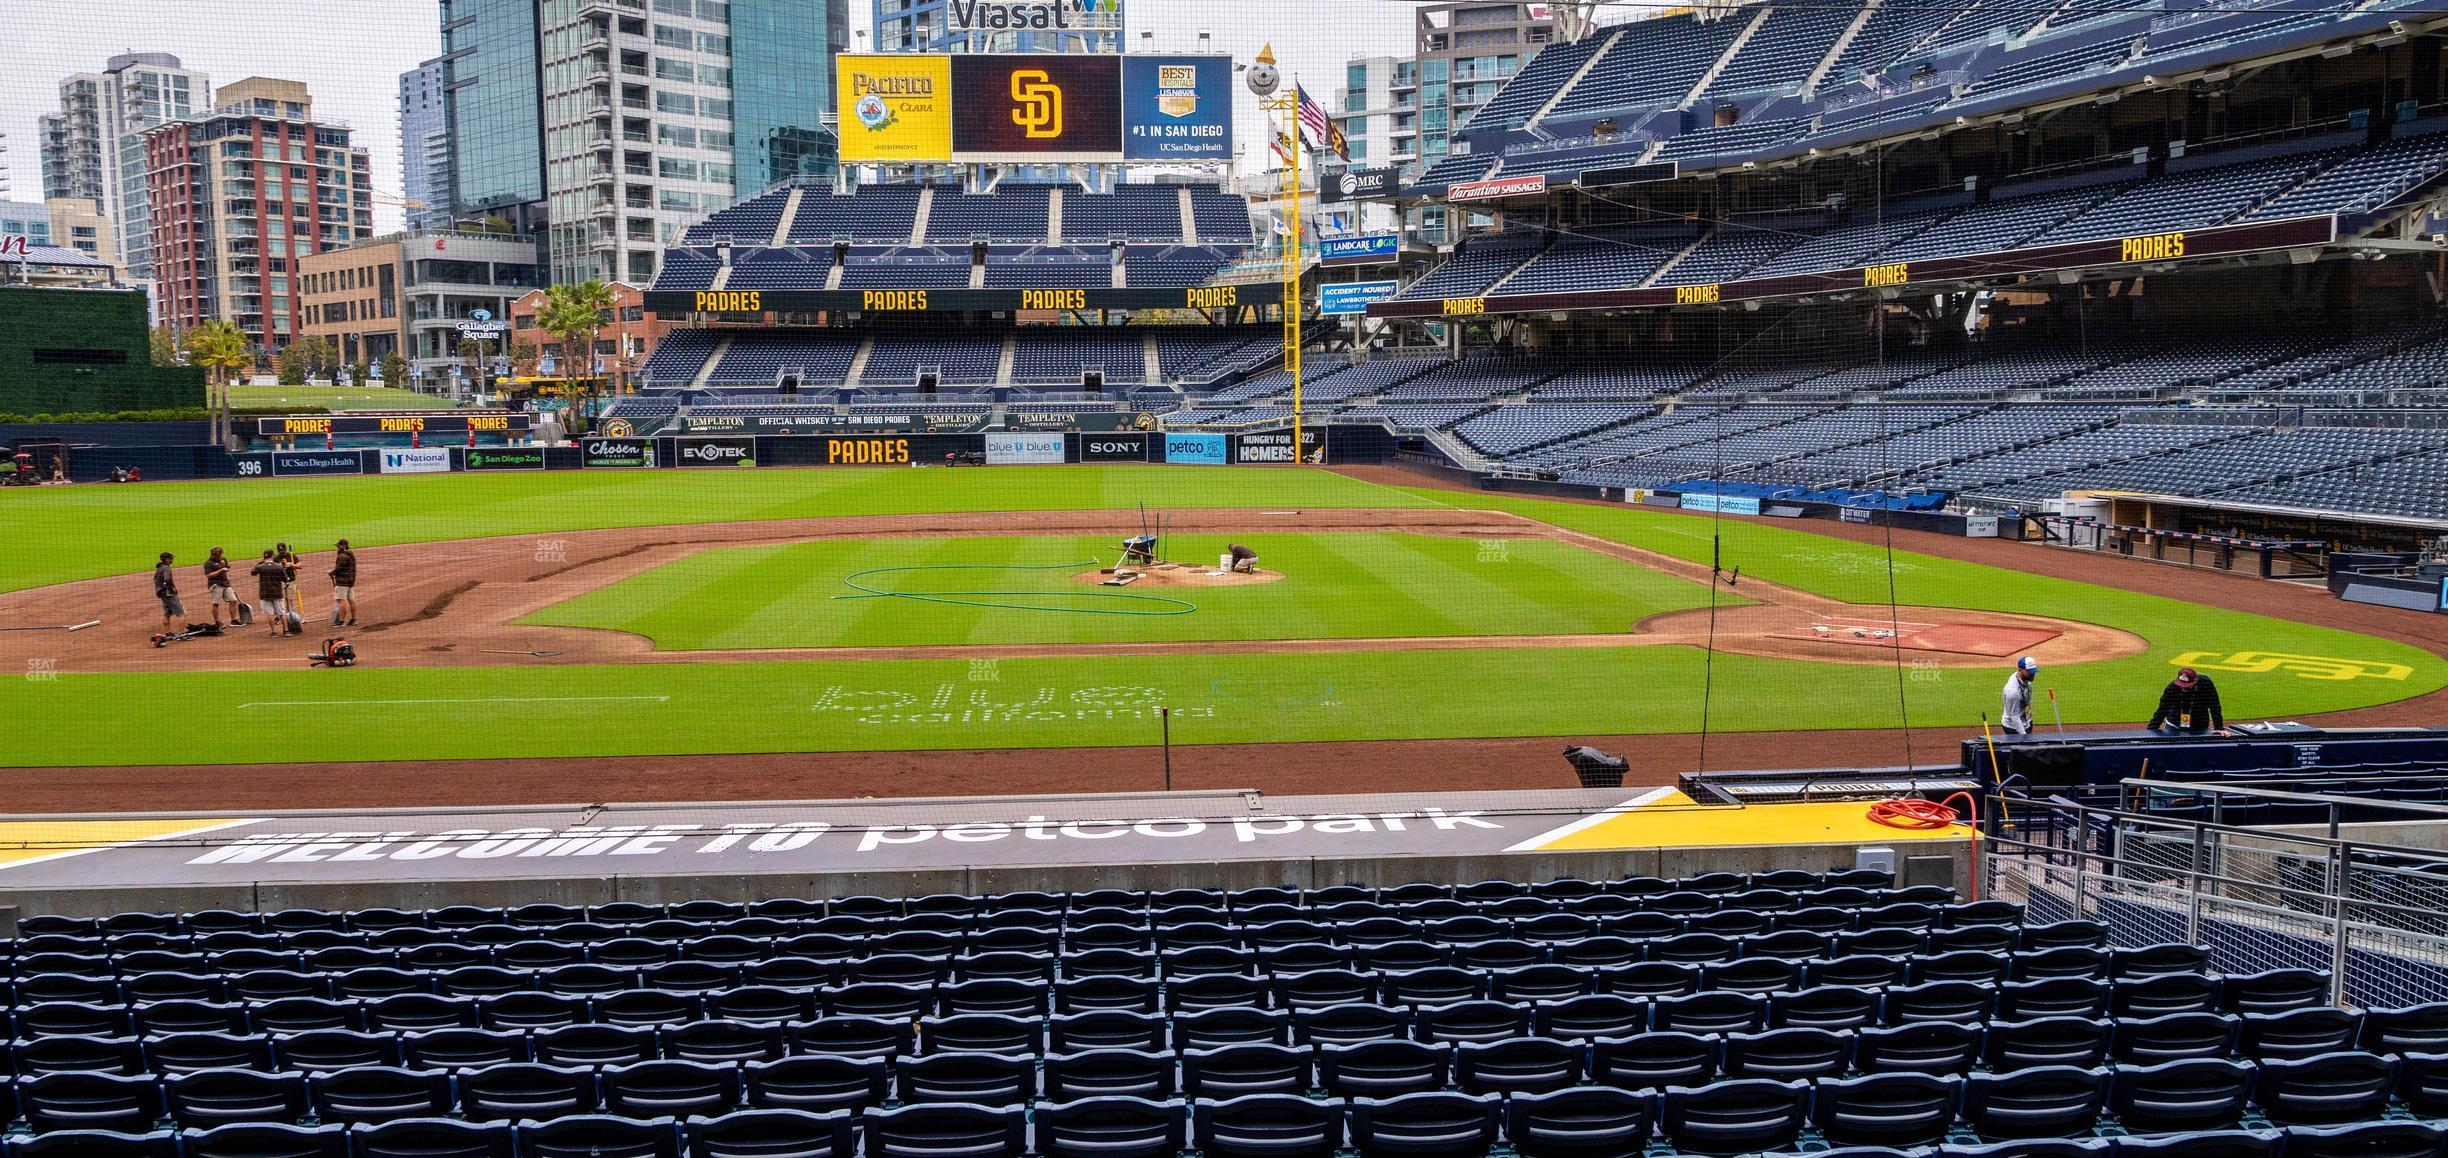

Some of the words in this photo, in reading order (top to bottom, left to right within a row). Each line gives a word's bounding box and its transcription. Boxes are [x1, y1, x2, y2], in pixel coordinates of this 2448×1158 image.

[952, 0, 1069, 29] Viasat
[1161, 67, 1193, 79] BEST
[852, 72, 934, 96] PACIFICO
[1161, 79, 1193, 88] HOSPITALS
[899, 102, 933, 113] CLARA
[1133, 125, 1146, 137] #1
[1150, 125, 1162, 137] IN
[1165, 125, 1188, 137] SAN
[1191, 125, 1223, 137] DIEGO
[1160, 143, 1171, 151] UC
[1171, 143, 1184, 151] San
[1184, 143, 1202, 153] Diego
[1202, 143, 1223, 151] Health
[1357, 174, 1384, 187] MRC
[1451, 183, 1501, 199] Tarantino
[1501, 181, 1543, 195] SAUSAGES
[1333, 240, 1371, 252] LANDCARE
[2122, 233, 2184, 262] PADRES
[1864, 264, 1908, 286] PADRES
[1187, 286, 1237, 308] PADRES
[1324, 287, 1361, 296] ACCIDENT?
[1676, 284, 1719, 304] PADRES
[696, 291, 760, 311] PADRES
[864, 290, 927, 310] PADRES
[1022, 289, 1086, 309] PADRES
[1443, 298, 1485, 315] PADRES
[456, 321, 505, 332] Gallagher
[463, 331, 499, 340] Square
[686, 416, 744, 426] TEMPLETON
[759, 417, 794, 426] OFFICIAL
[795, 416, 829, 425] WHISKEY
[848, 416, 863, 424] SAN
[864, 416, 883, 424] DIEGO
[884, 416, 910, 424] PADRES
[923, 415, 981, 424] TEMPLETON
[1018, 414, 1075, 423] TEMPLETON
[1243, 435, 1274, 444] HUNGRY
[1275, 435, 1291, 444] FOR
[1300, 432, 1315, 444] 322
[589, 440, 640, 455] Chosen
[683, 444, 747, 461] EVOTEK
[828, 439, 909, 464] PADRES
[988, 442, 1012, 451] blue
[1026, 442, 1050, 451] blue
[1090, 442, 1141, 453] SONY
[1169, 441, 1204, 454] petco
[405, 453, 445, 462] National
[1240, 446, 1295, 461] HOMERS
[281, 459, 293, 468] UC
[309, 459, 330, 468] Diego
[330, 458, 354, 467] Health
[501, 456, 525, 465] Diego
[526, 455, 541, 463] Zoo
[238, 460, 262, 476] 396
[1681, 496, 1699, 507] petco
[1720, 500, 1739, 511] petco
[1814, 783, 1892, 792] PADRES
[185, 825, 702, 864] WELCOME
[695, 822, 831, 853] TO
[857, 815, 1208, 851] petco
[1234, 808, 1505, 842] park
